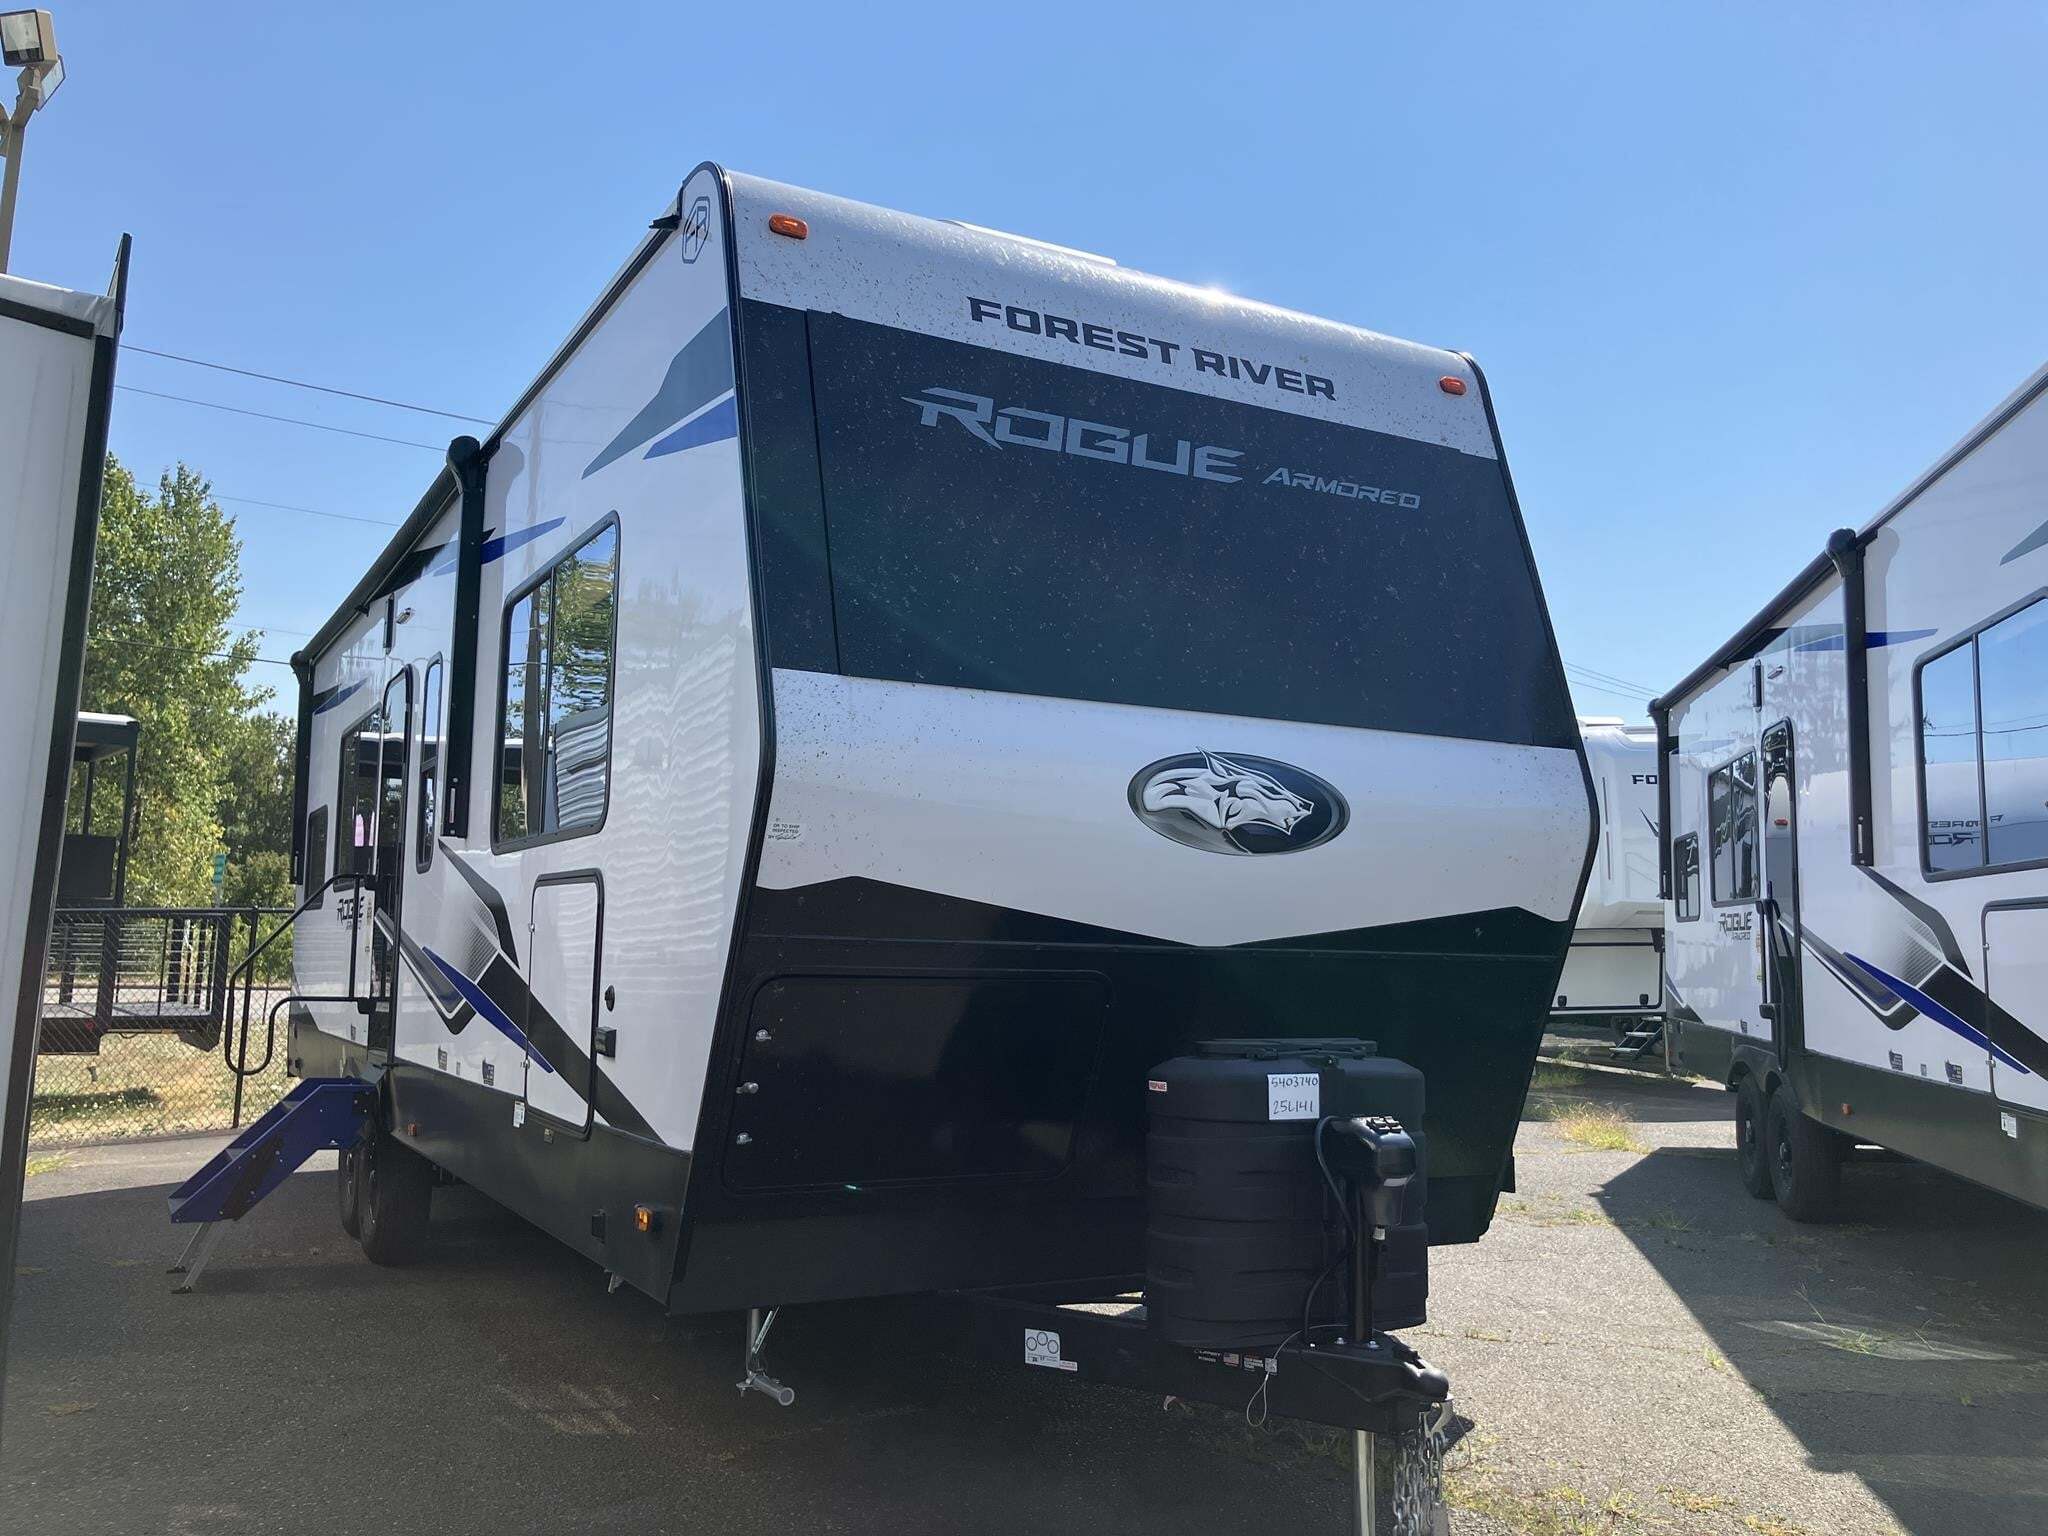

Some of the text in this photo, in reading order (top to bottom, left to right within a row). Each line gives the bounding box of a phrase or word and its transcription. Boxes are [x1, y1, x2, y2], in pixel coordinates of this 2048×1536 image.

[967, 296, 1337, 401] FOREST RIVER
[901, 386, 1421, 510] ROGUE ARMORED
[1271, 1076, 1319, 1088] 5403740
